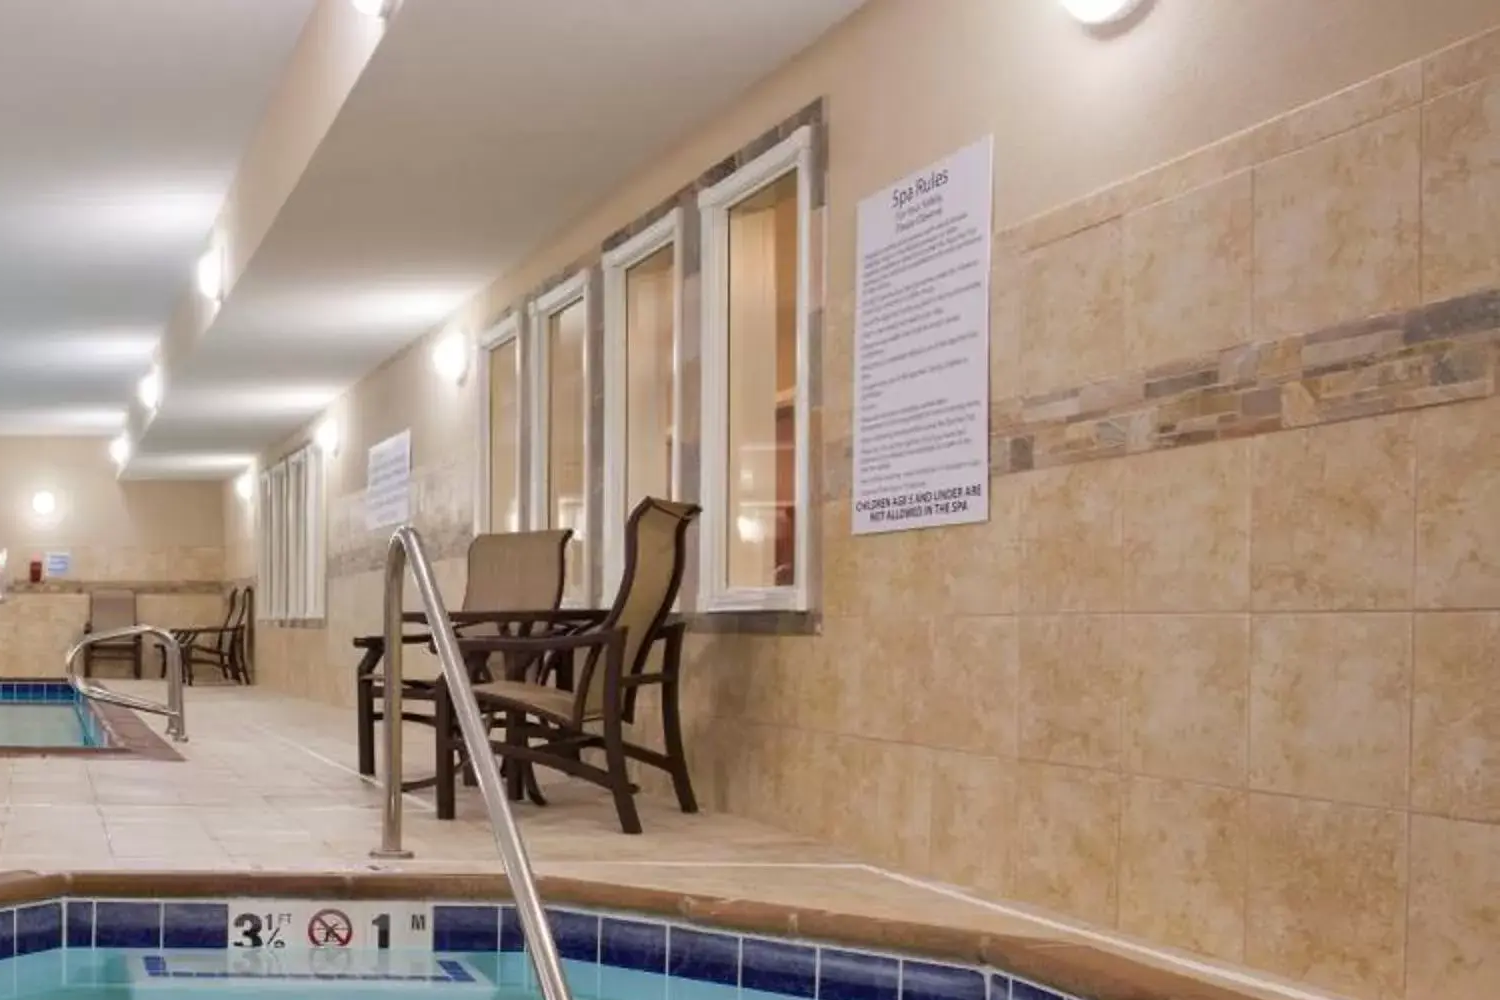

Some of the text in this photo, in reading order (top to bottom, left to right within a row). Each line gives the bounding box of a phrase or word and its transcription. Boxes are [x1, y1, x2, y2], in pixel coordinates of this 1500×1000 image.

[892, 187, 913, 209] Spa
[915, 169, 949, 197] Rules
[856, 497, 890, 512] CHILDREN
[916, 490, 932, 503] AND
[934, 487, 962, 500] UNDER
[965, 484, 981, 496] ARE
[870, 500, 968, 522] NOT ALLOWED IN THE SPA
[278, 913, 292, 924] FT
[372, 914, 390, 948] 1
[411, 914, 425, 930] M
